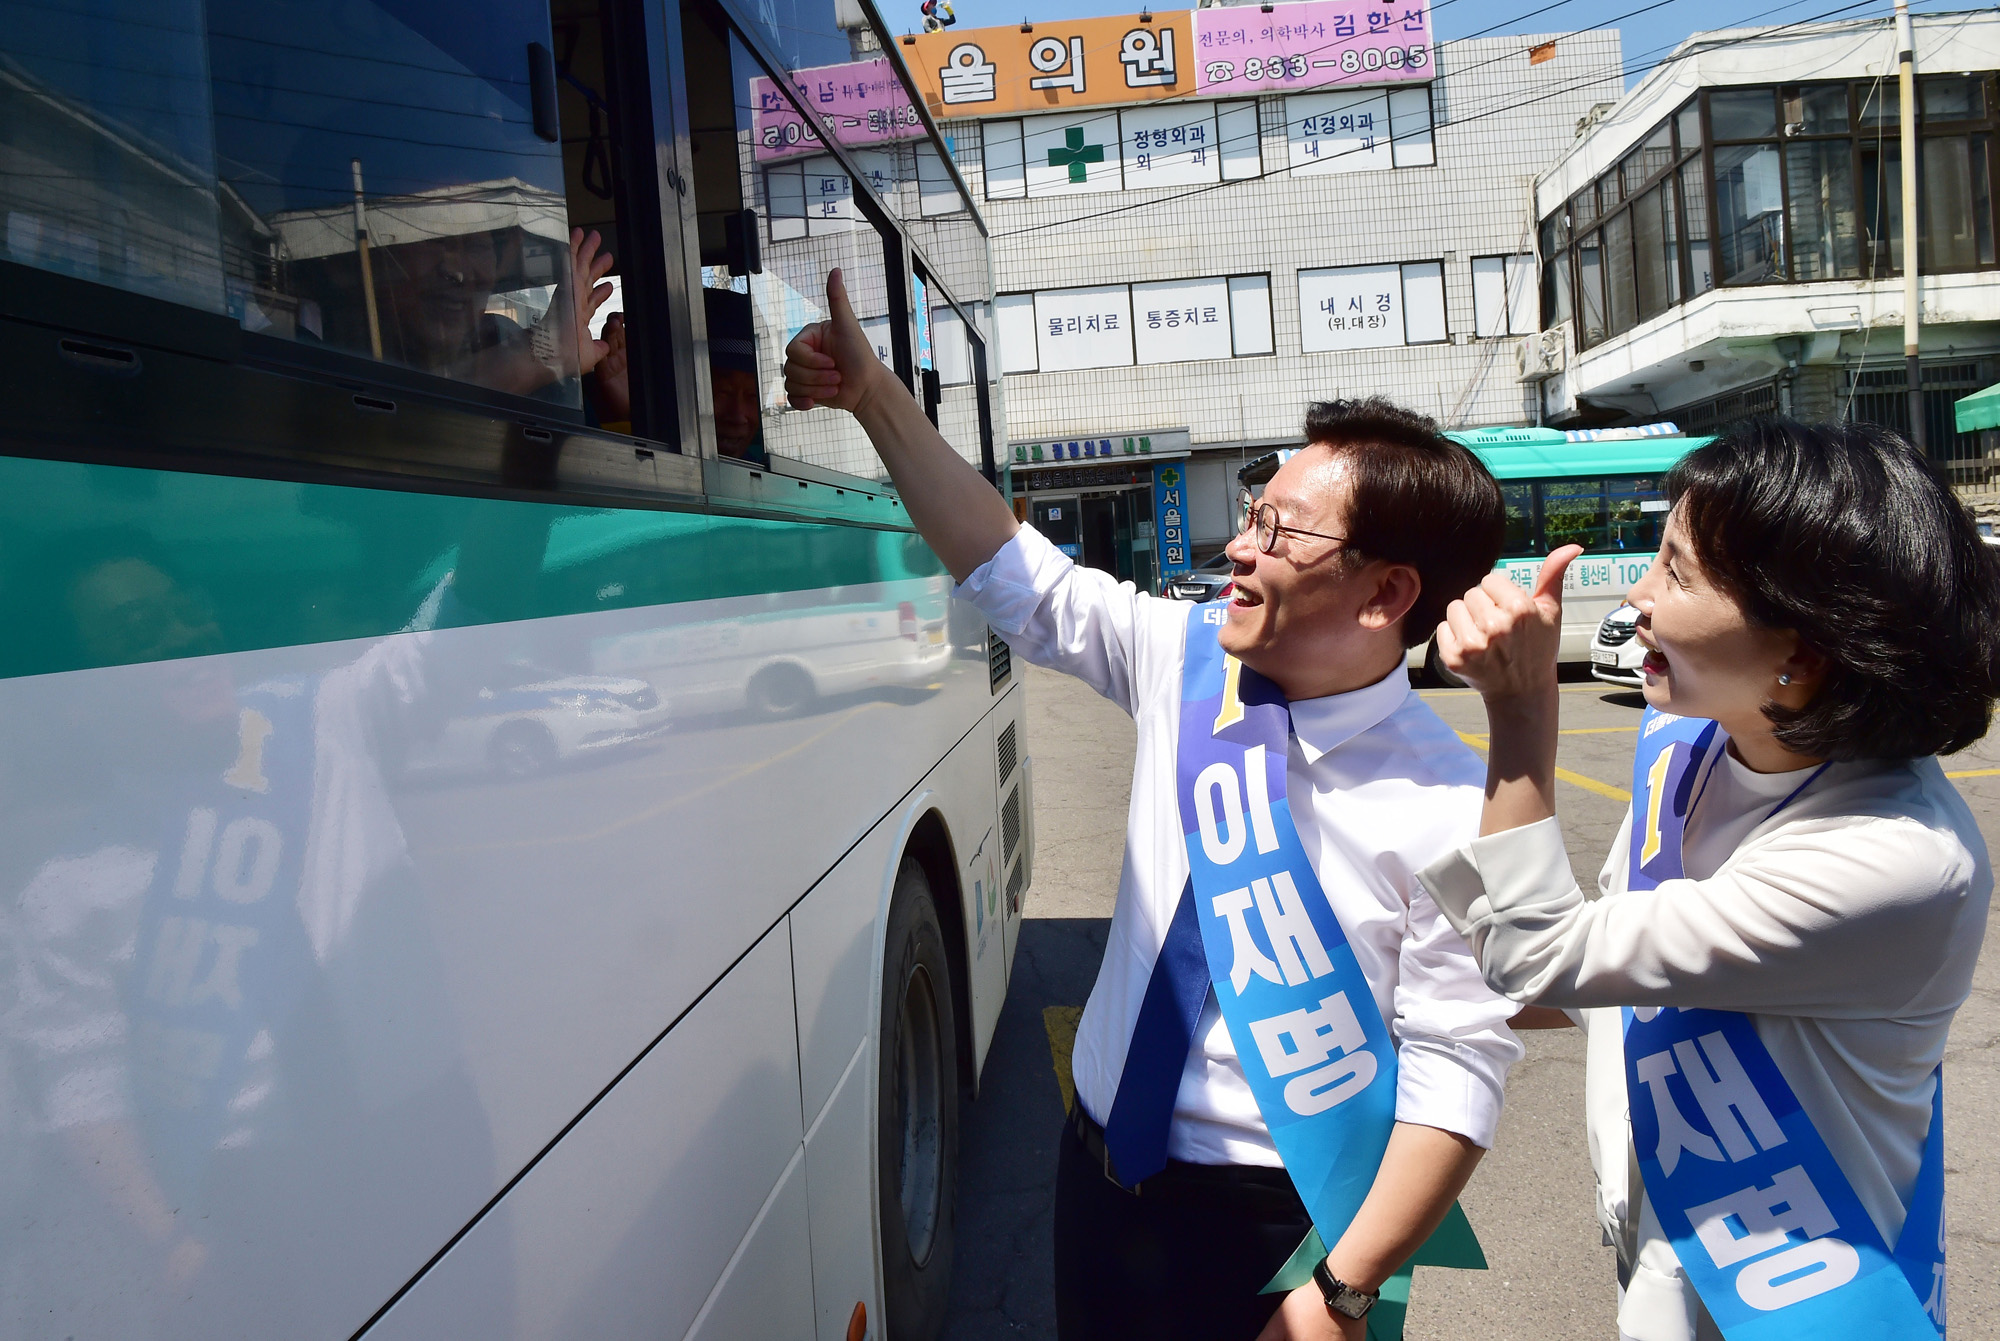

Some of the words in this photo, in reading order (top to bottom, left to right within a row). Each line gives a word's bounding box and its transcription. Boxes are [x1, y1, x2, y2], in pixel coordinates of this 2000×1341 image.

[1261, 22, 1325, 42] 의학박사
[1302, 112, 1374, 136] 신경외과
[1134, 125, 1205, 149] 정형외과
[1047, 312, 1121, 337] 물리치료
[1146, 306, 1219, 330] 통증치료
[1052, 439, 1112, 461] 정형외과
[1123, 436, 1151, 453] 내과
[1162, 490, 1185, 565] 서울의원
[1640, 741, 1678, 870] 1
[1193, 744, 1378, 1116] 이재명
[1632, 1007, 1861, 1312] 재명
